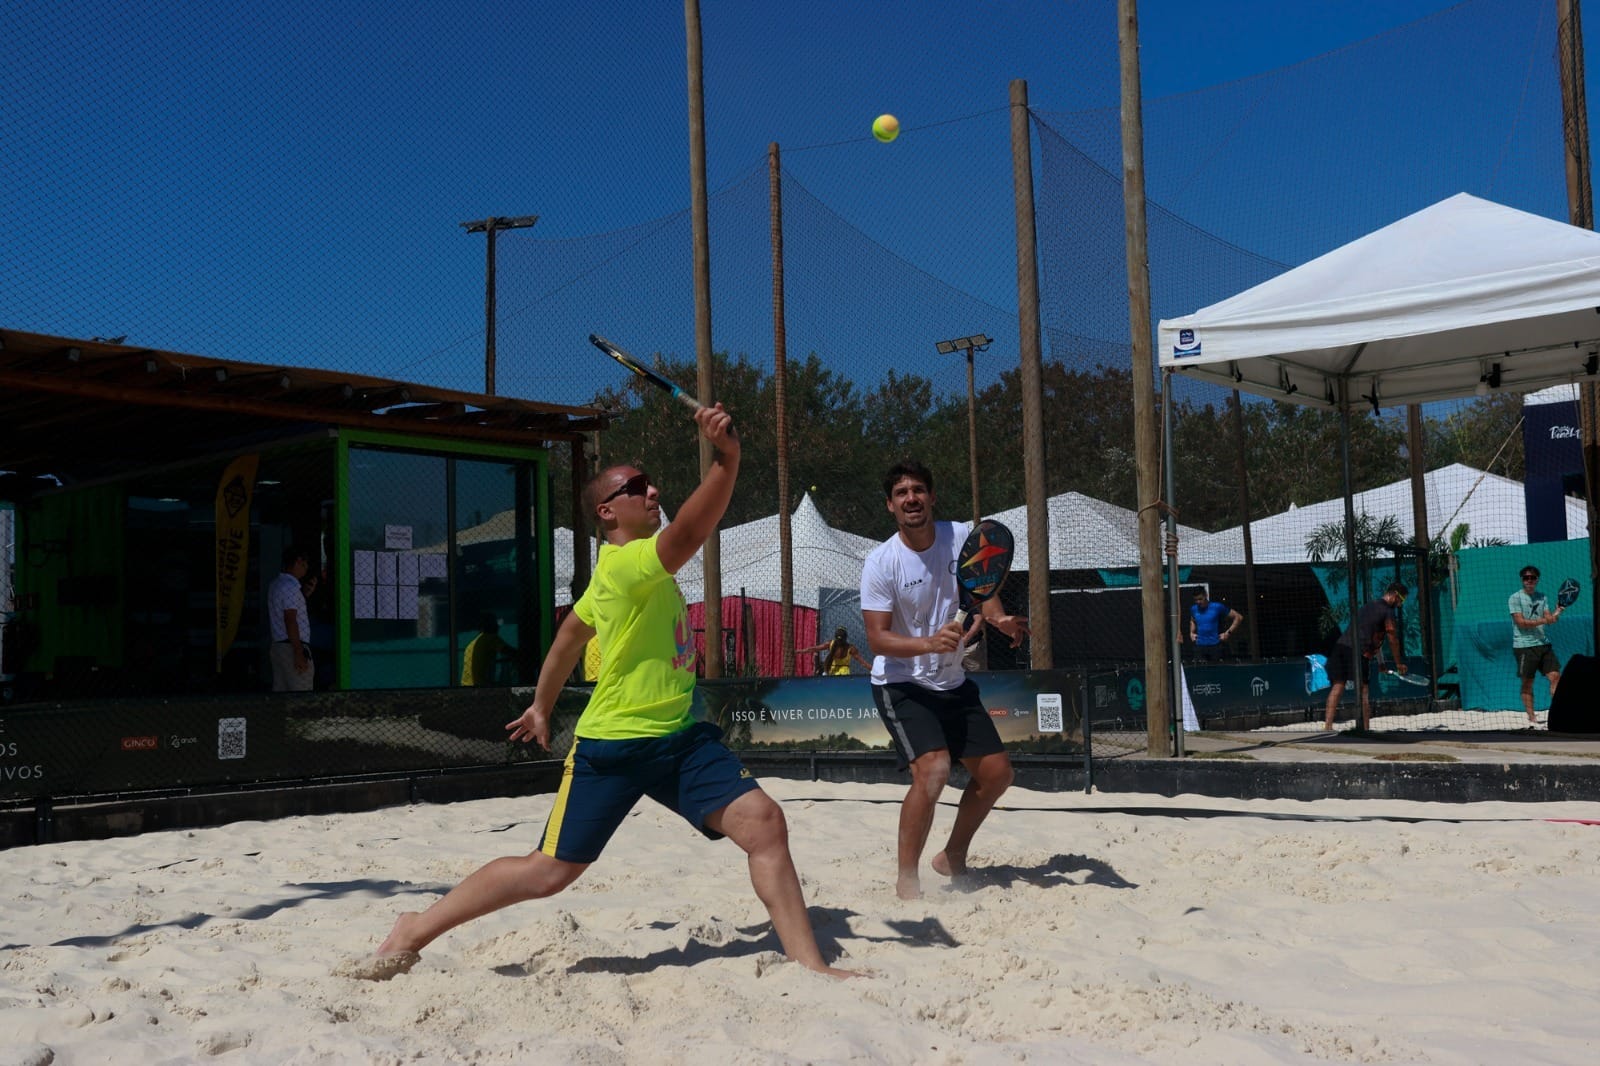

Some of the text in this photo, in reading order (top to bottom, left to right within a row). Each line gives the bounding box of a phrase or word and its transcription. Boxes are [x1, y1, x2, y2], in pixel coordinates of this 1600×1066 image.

[223, 529, 244, 581] MOVE
[731, 710, 756, 722] ISSO
[760, 707, 766, 721] É
[770, 709, 804, 721] VIVER
[807, 708, 853, 720] CIDADE
